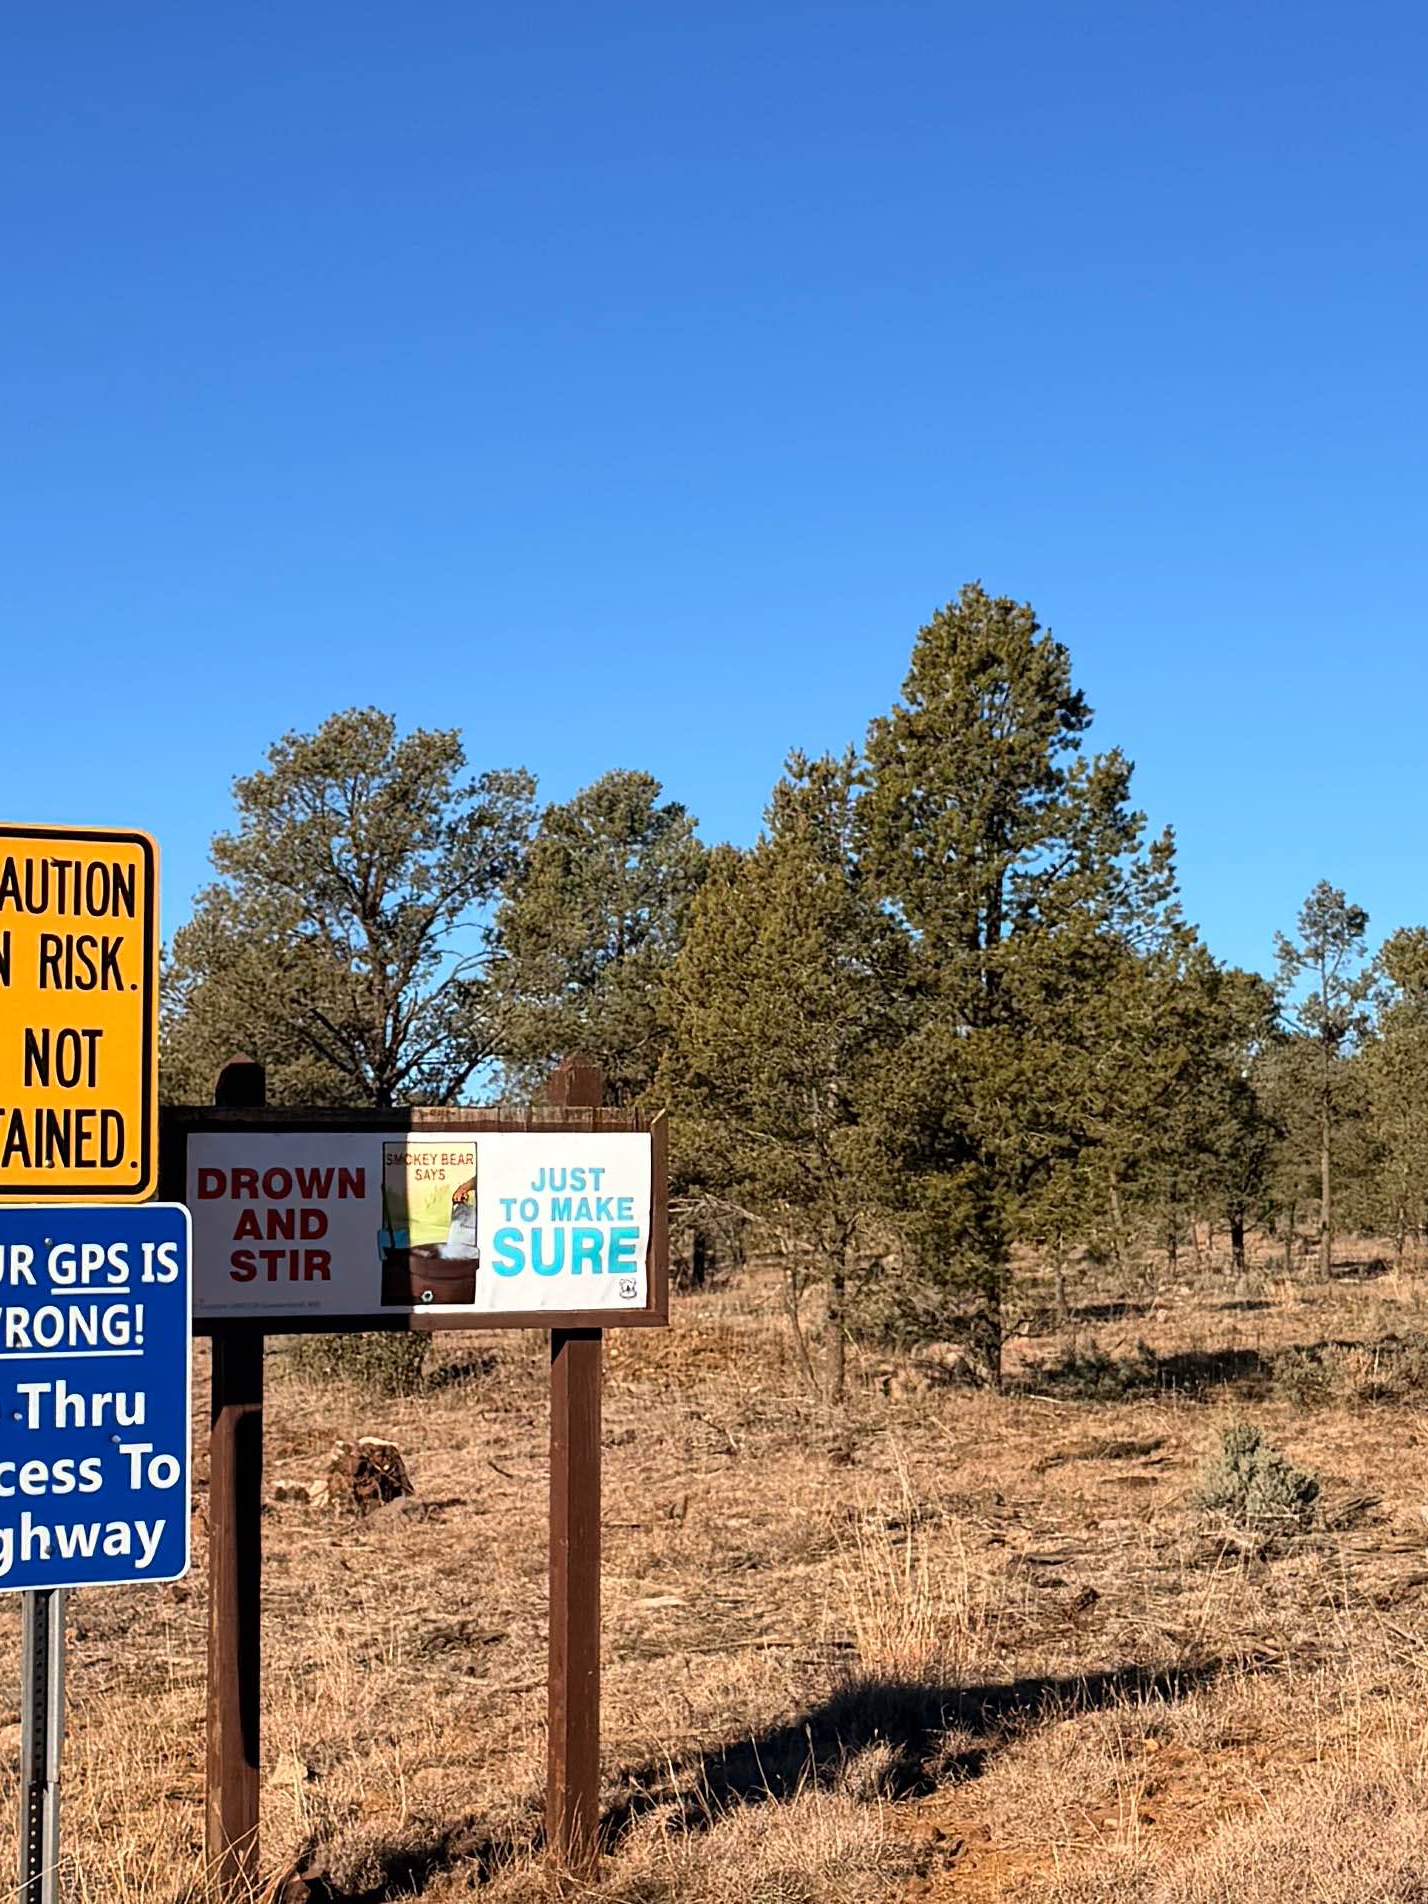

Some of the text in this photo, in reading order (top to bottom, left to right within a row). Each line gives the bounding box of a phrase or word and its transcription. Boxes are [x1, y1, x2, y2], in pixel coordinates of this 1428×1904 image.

[40, 934, 137, 990] RISK.
[25, 1028, 102, 1088] NOT
[386, 1153, 474, 1167] SMOKEY BEAR
[415, 1169, 445, 1181] SAYS
[198, 1167, 365, 1199] DROWN
[532, 1168, 605, 1191] JUST
[234, 1209, 327, 1240] AND
[500, 1197, 633, 1222] TO MAKE
[48, 1243, 129, 1285] GPS
[141, 1242, 178, 1283] IS
[230, 1250, 331, 1282] STIR
[492, 1227, 639, 1276] SURE
[17, 1380, 145, 1429] Thru
[119, 1443, 180, 1490] To
